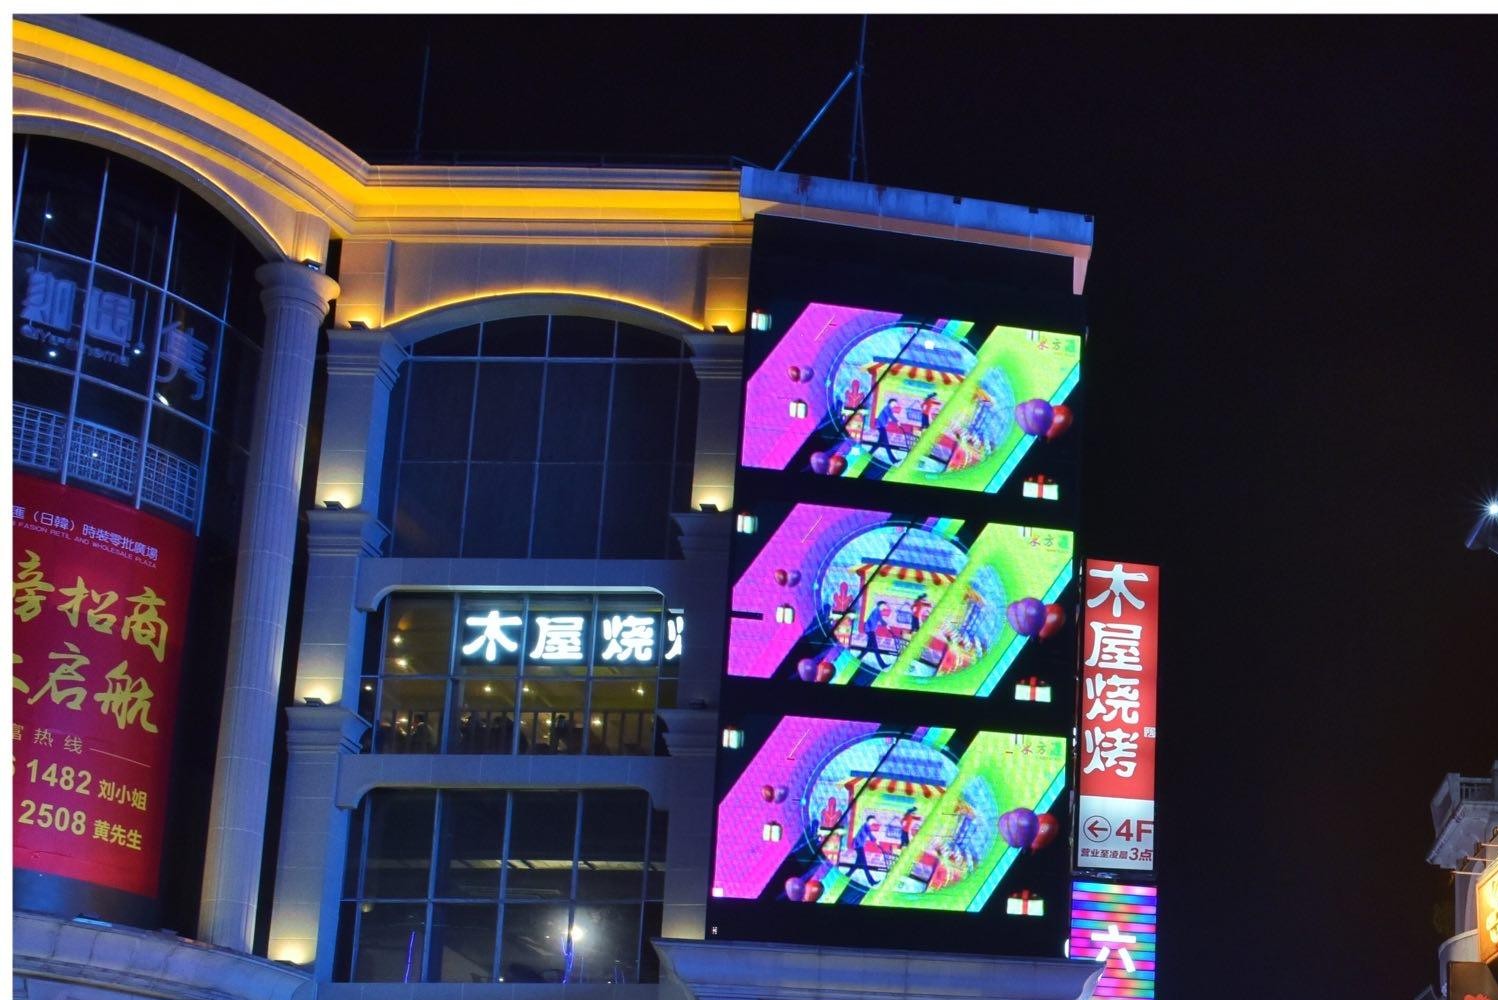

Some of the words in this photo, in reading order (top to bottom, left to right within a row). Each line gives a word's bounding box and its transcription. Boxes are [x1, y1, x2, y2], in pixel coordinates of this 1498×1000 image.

[13, 642, 159, 734] 启航
[1083, 563, 1149, 778] 木屋烧烤
[26, 759, 91, 796] 1482
[98, 778, 148, 812] 刘小姐
[18, 801, 87, 836] 2508
[93, 819, 142, 851] 黄先生
[1115, 819, 1154, 842] 4F
[1081, 847, 1153, 862] 营业至凌晨3点
